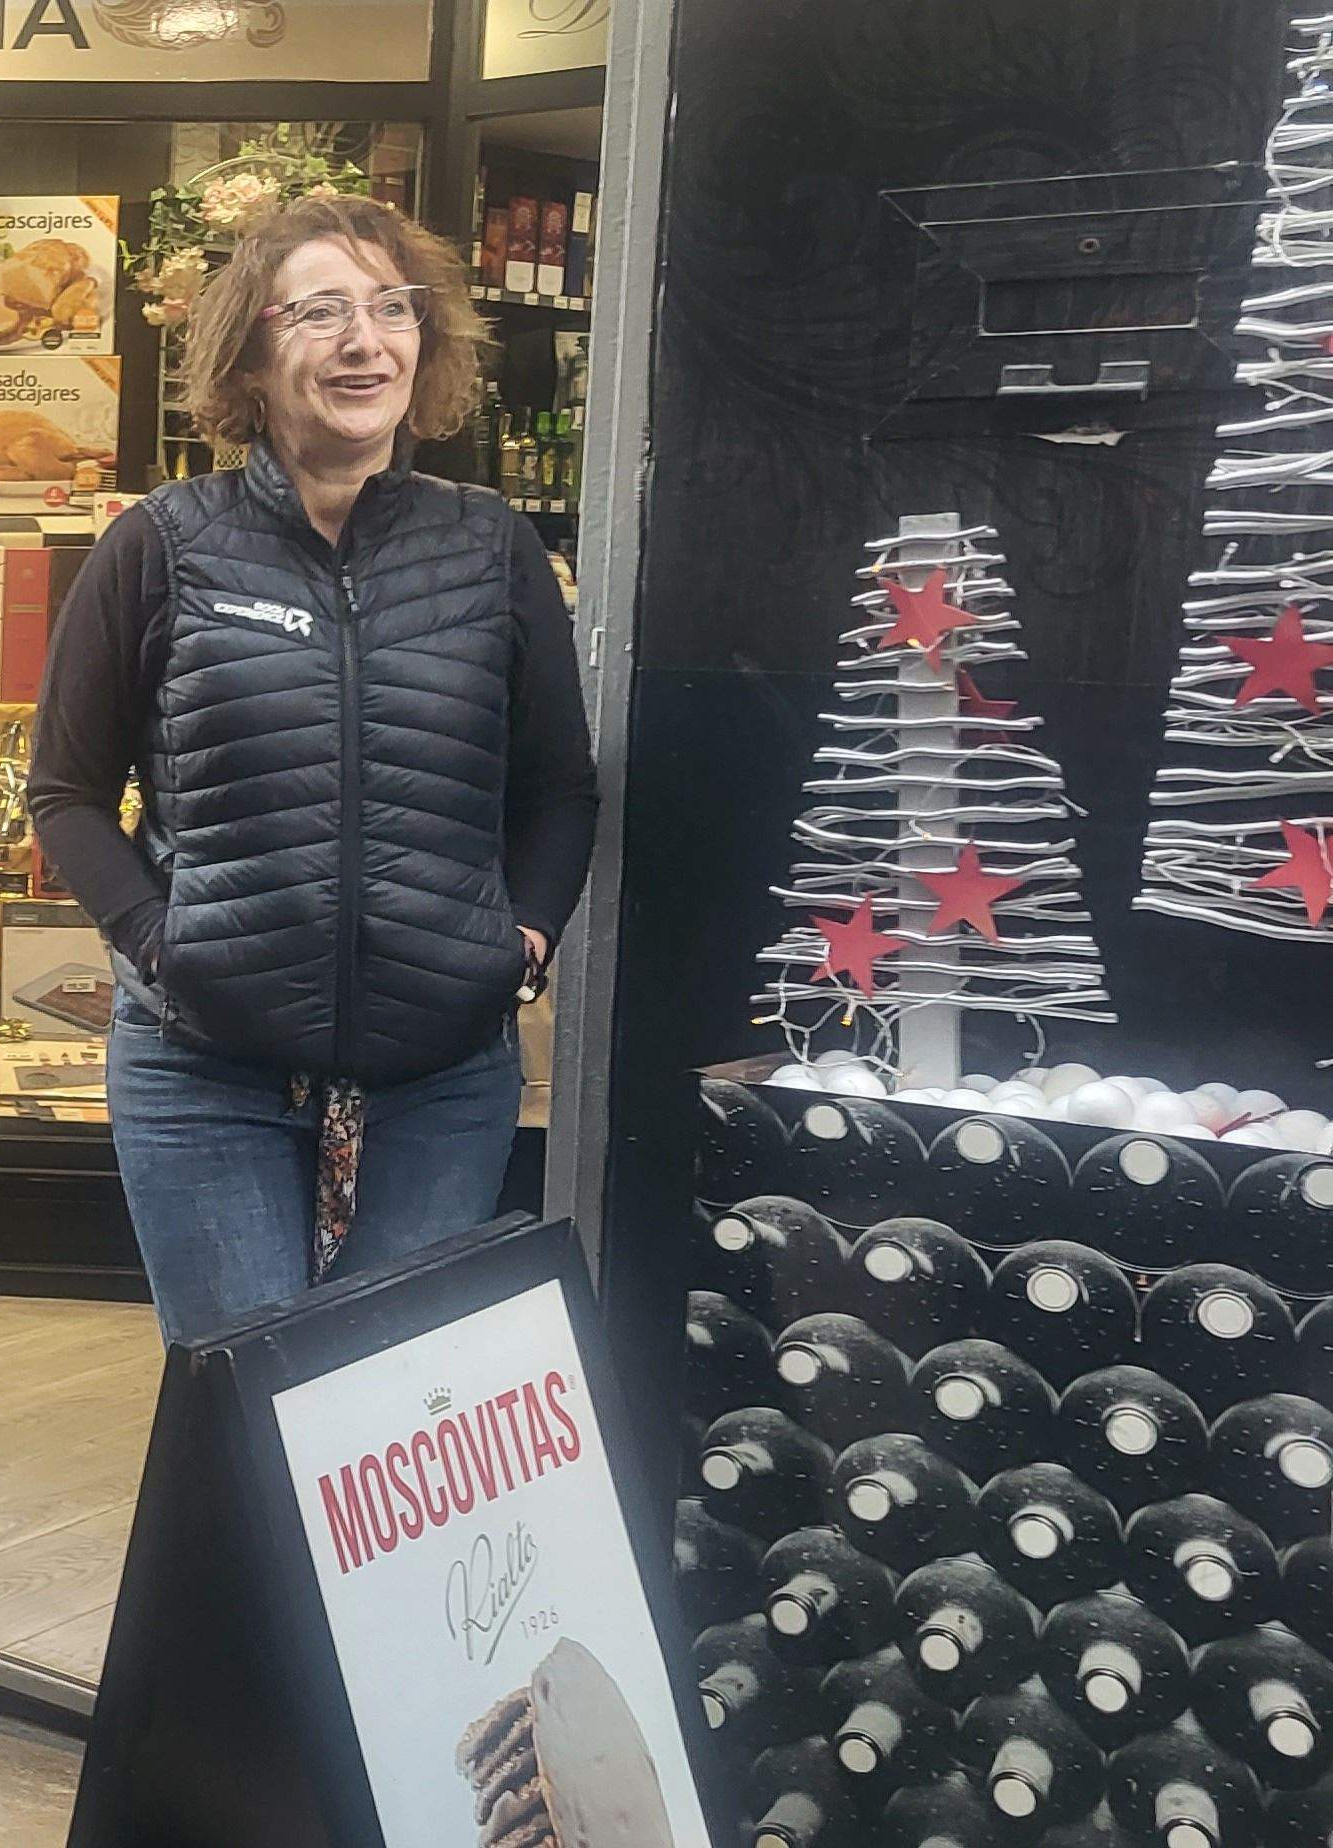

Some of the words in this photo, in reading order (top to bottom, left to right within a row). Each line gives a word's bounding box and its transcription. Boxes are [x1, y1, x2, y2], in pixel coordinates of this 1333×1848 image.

[317, 1371, 581, 1575] MOSCOVITAS
[445, 1520, 539, 1662] Rialto
[520, 1605, 560, 1639] 1926
